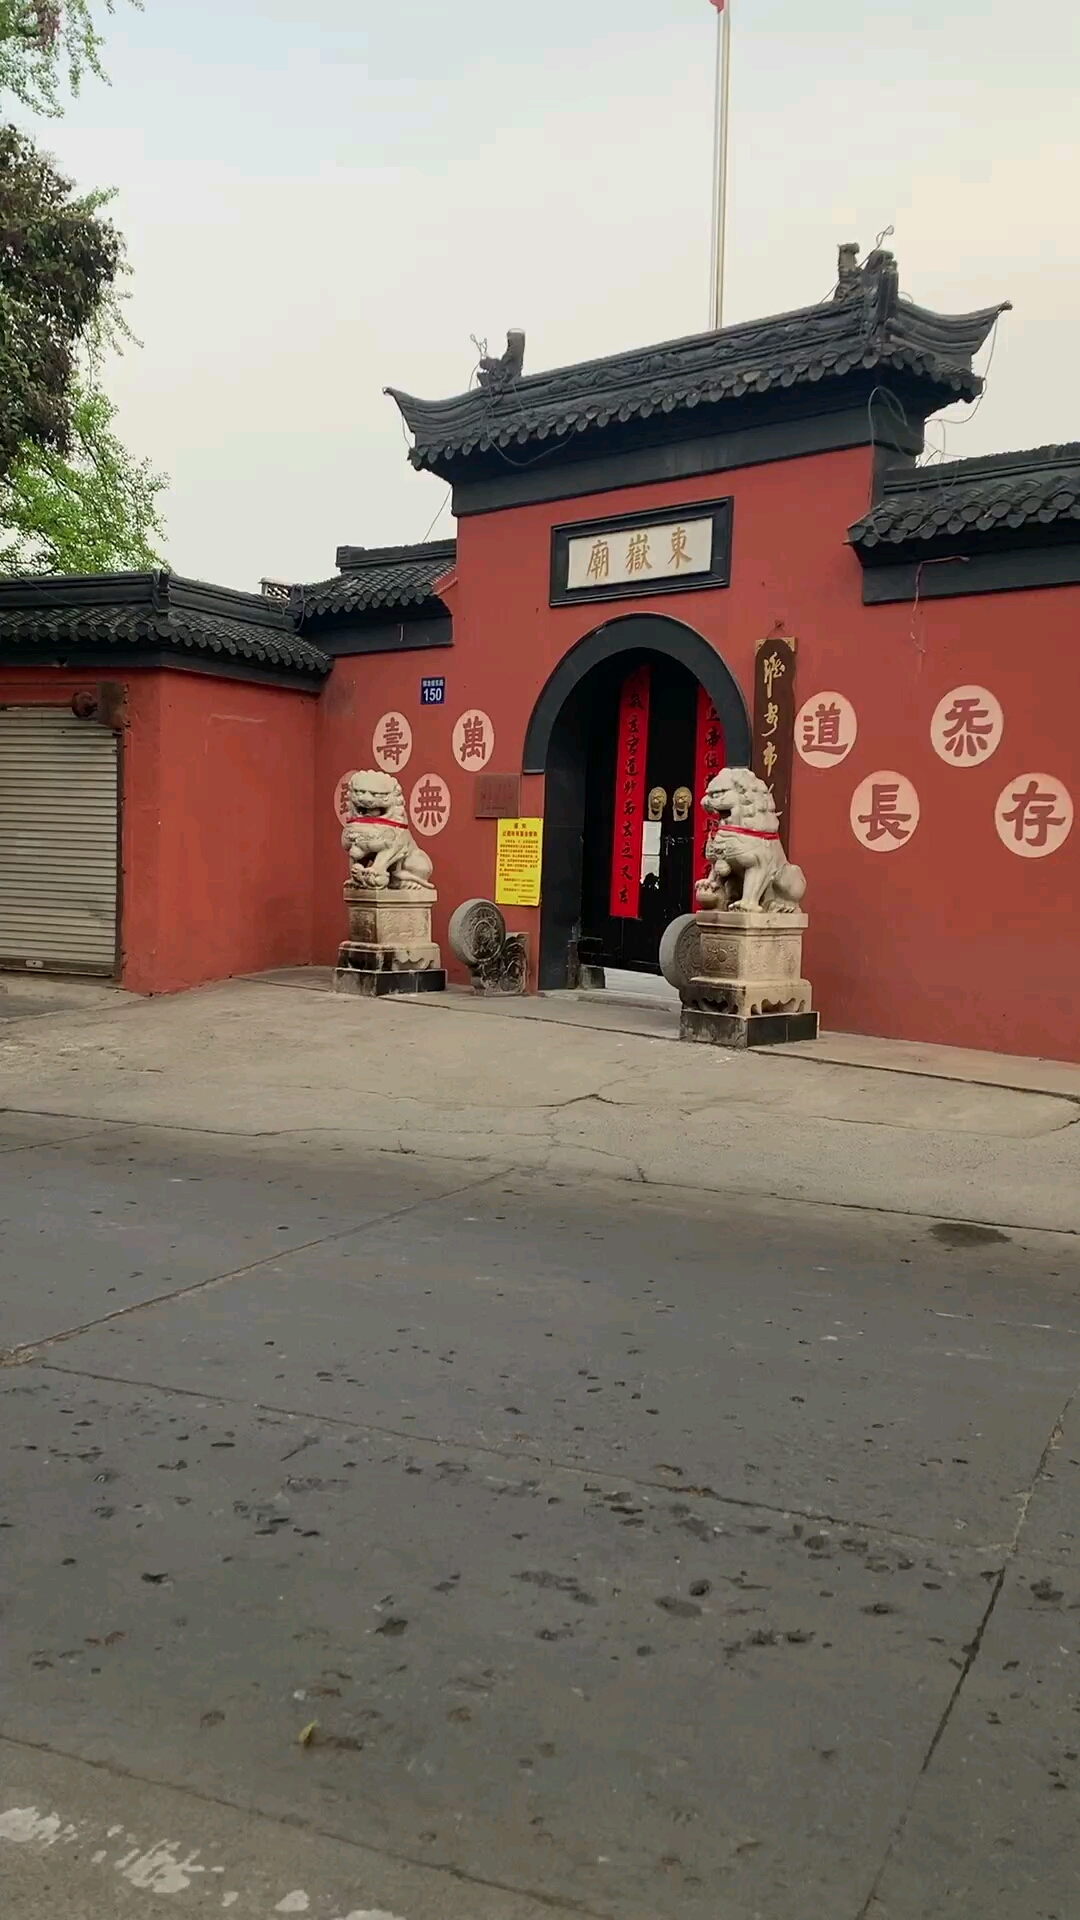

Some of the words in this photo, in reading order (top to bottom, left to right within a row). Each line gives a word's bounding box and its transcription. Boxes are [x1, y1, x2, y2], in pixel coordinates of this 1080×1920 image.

[587, 526, 692, 581] 東嶽廟
[424, 688, 442, 701] 150
[376, 716, 408, 765] 壽
[460, 716, 486, 762] 萬
[759, 652, 786, 795] 淮安市
[802, 702, 849, 755] 道
[414, 779, 447, 828] 無
[858, 783, 911, 842] 長
[1002, 780, 1066, 847] 存
